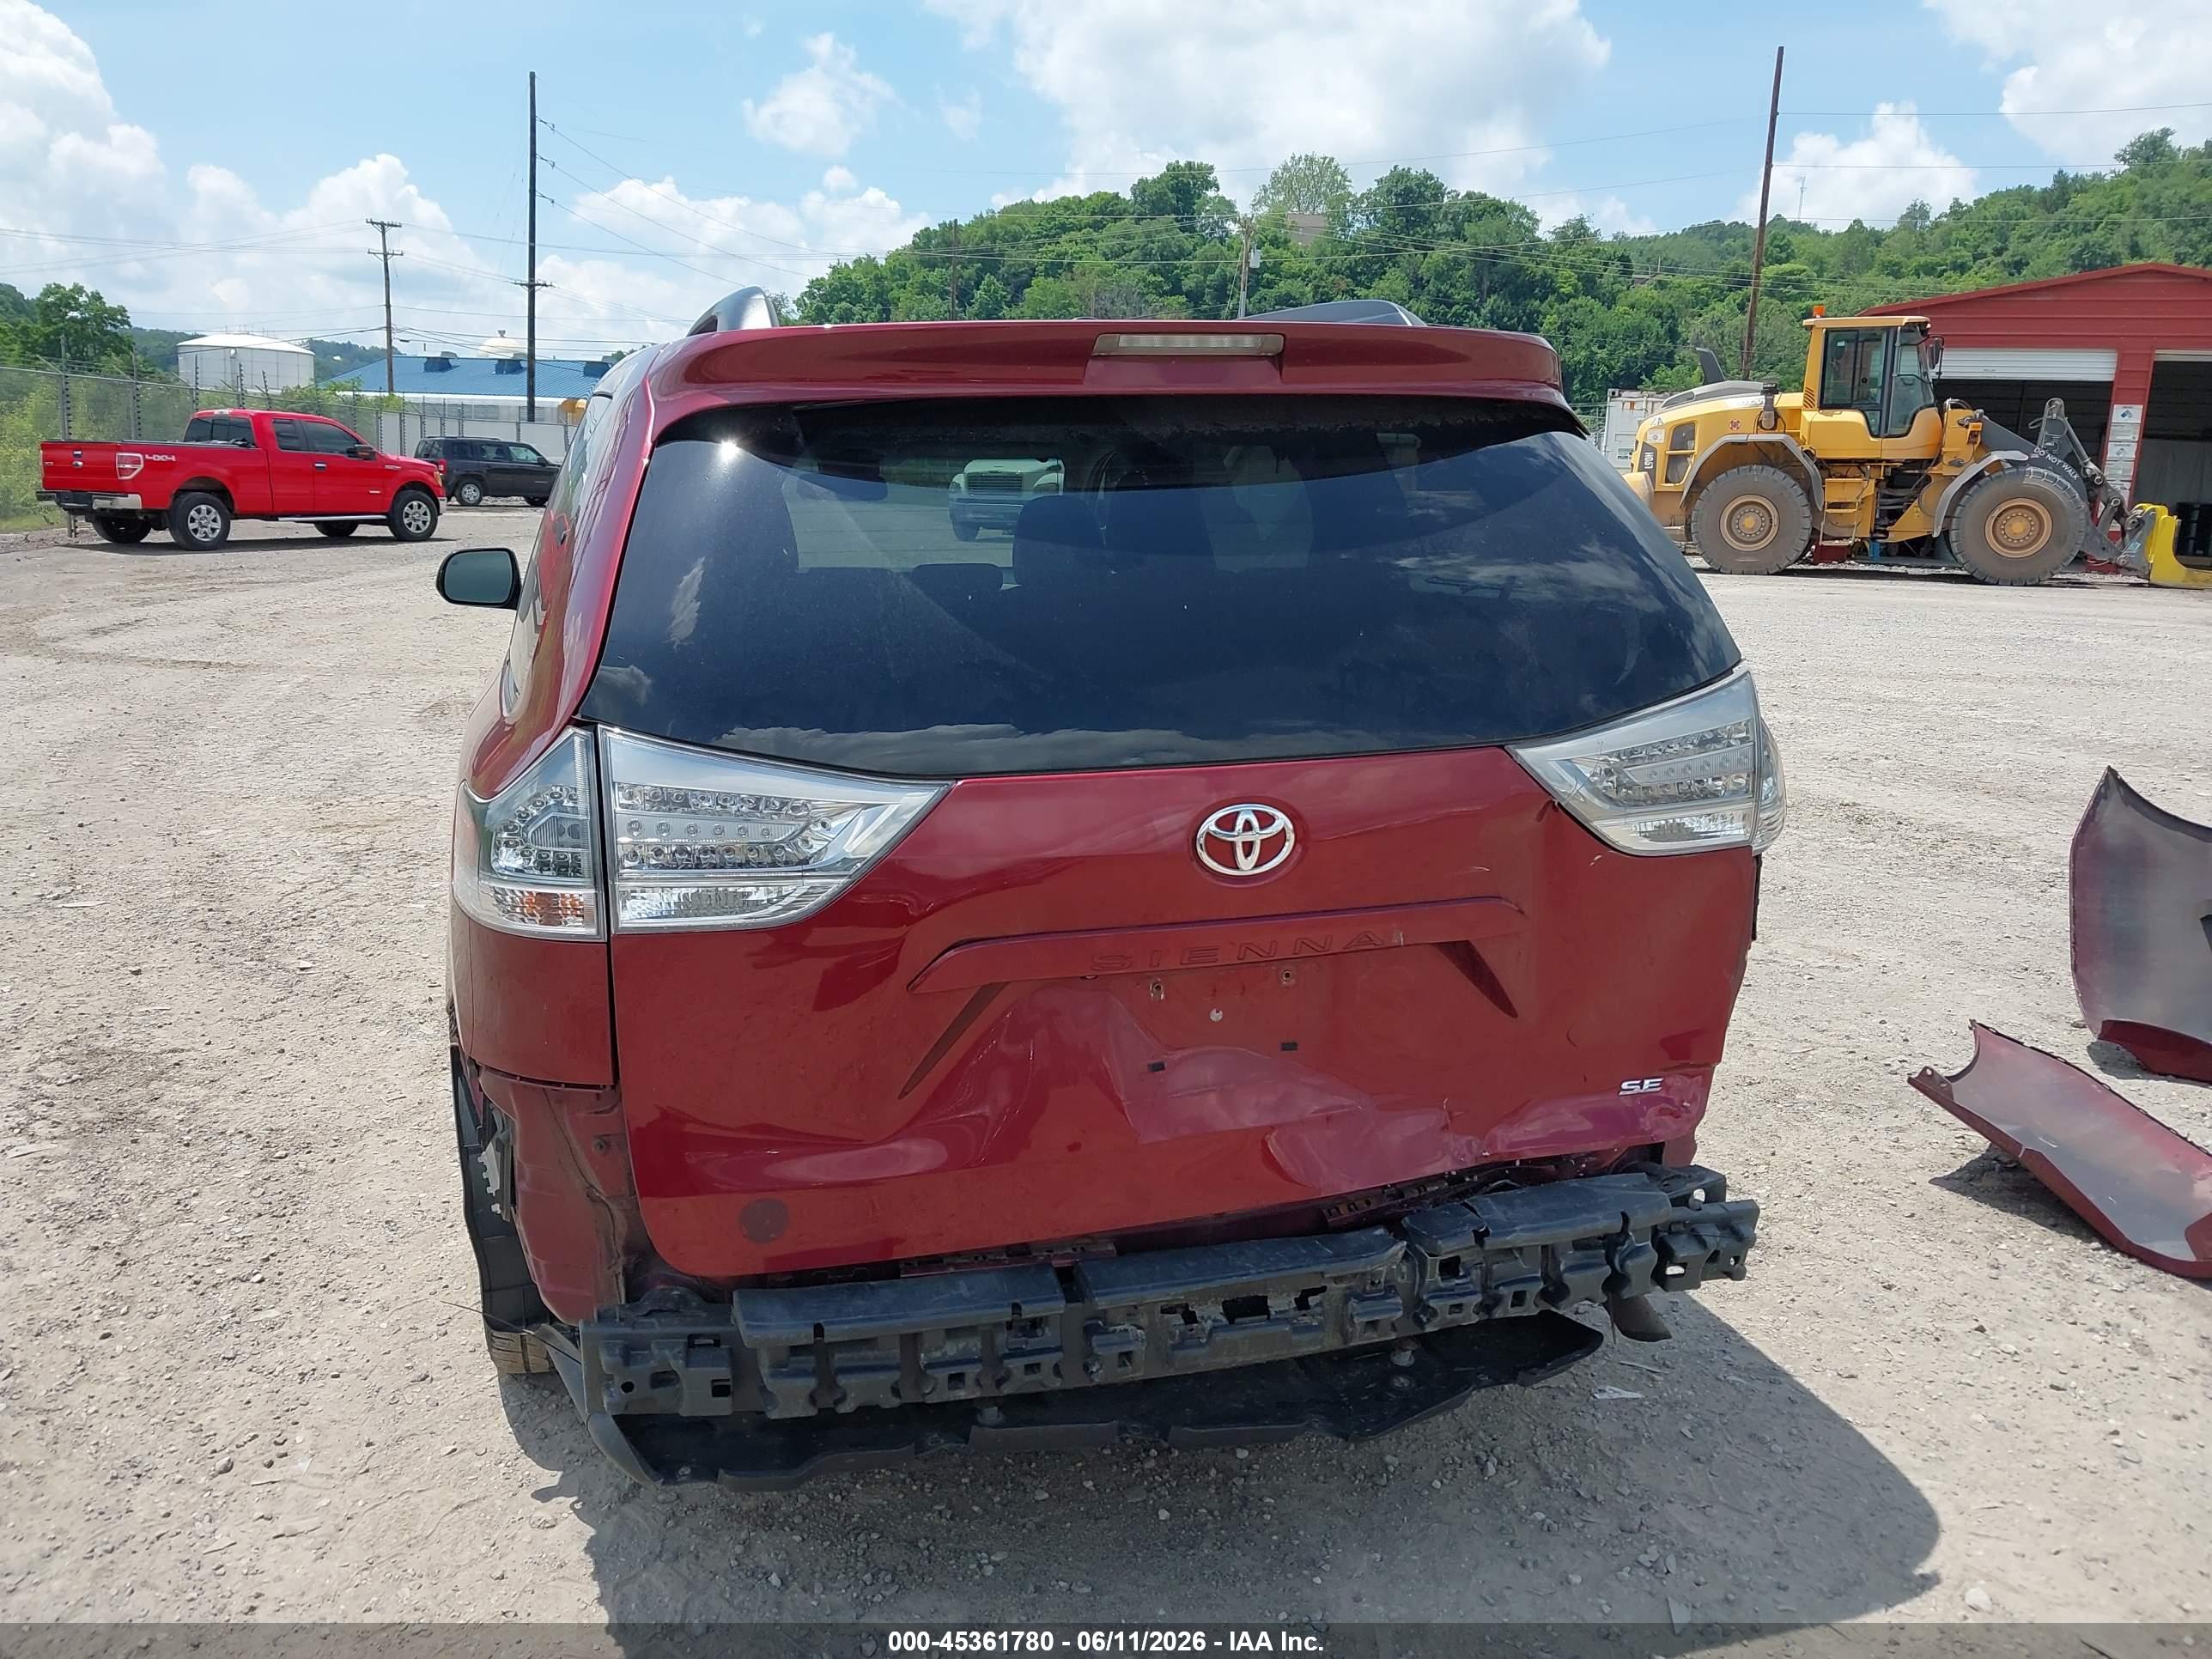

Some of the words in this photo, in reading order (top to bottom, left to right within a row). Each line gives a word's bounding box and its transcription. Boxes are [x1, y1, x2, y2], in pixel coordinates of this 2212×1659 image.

[2033, 447, 2045, 456] DO
[2045, 453, 2064, 465] NOT
[2061, 463, 2080, 481] WALK
[1091, 931, 1385, 971] SIENNA
[1618, 1077, 1665, 1096] SE
